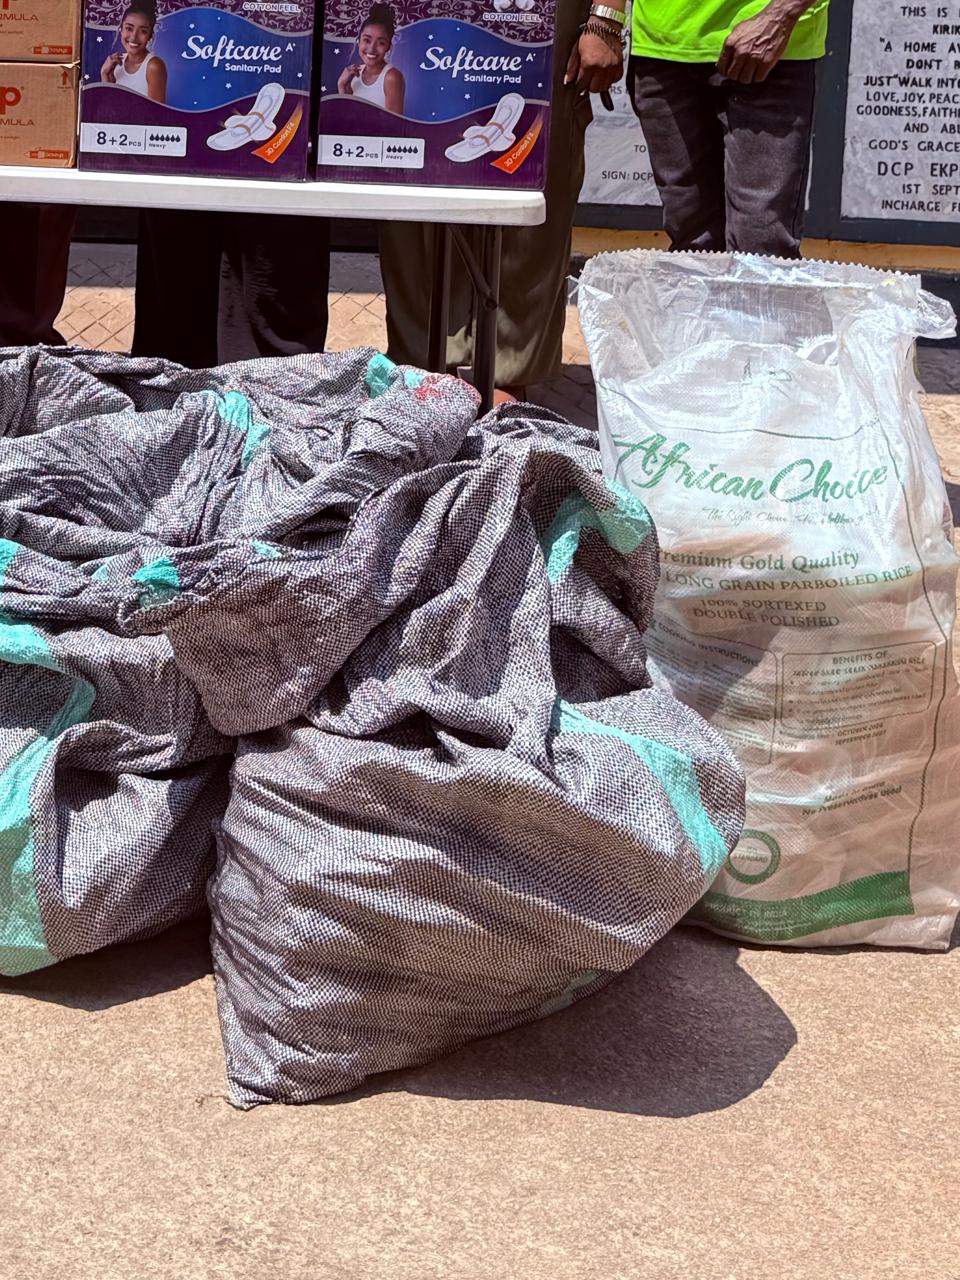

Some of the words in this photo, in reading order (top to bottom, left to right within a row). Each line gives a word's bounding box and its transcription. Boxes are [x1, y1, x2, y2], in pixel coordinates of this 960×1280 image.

[900, 6, 927, 17] THIS
[937, 8, 947, 18] IS
[181, 36, 282, 67] Softcare
[904, 42, 936, 52] HOME
[225, 63, 262, 73] Sanitary
[264, 64, 282, 73] Pad
[420, 47, 522, 78] Softcare
[464, 74, 502, 84] Sanitary
[503, 75, 522, 84] Pad
[864, 76, 891, 86] JUST
[904, 123, 929, 133] AND
[868, 139, 908, 150] GOD'S
[878, 161, 914, 176] DCP
[602, 171, 630, 180] SIGN:
[882, 200, 940, 212] INCHARGE
[611, 433, 765, 501] African
[769, 458, 887, 502] Choice
[659, 549, 733, 569] remium
[740, 553, 784, 571] Gold
[792, 551, 860, 572] Quality
[719, 577, 775, 592] GRAIN
[781, 574, 878, 591] PARBOILED
[883, 565, 913, 584] RICE
[743, 599, 826, 612] SORTEXED
[761, 611, 840, 628] POLISHED
